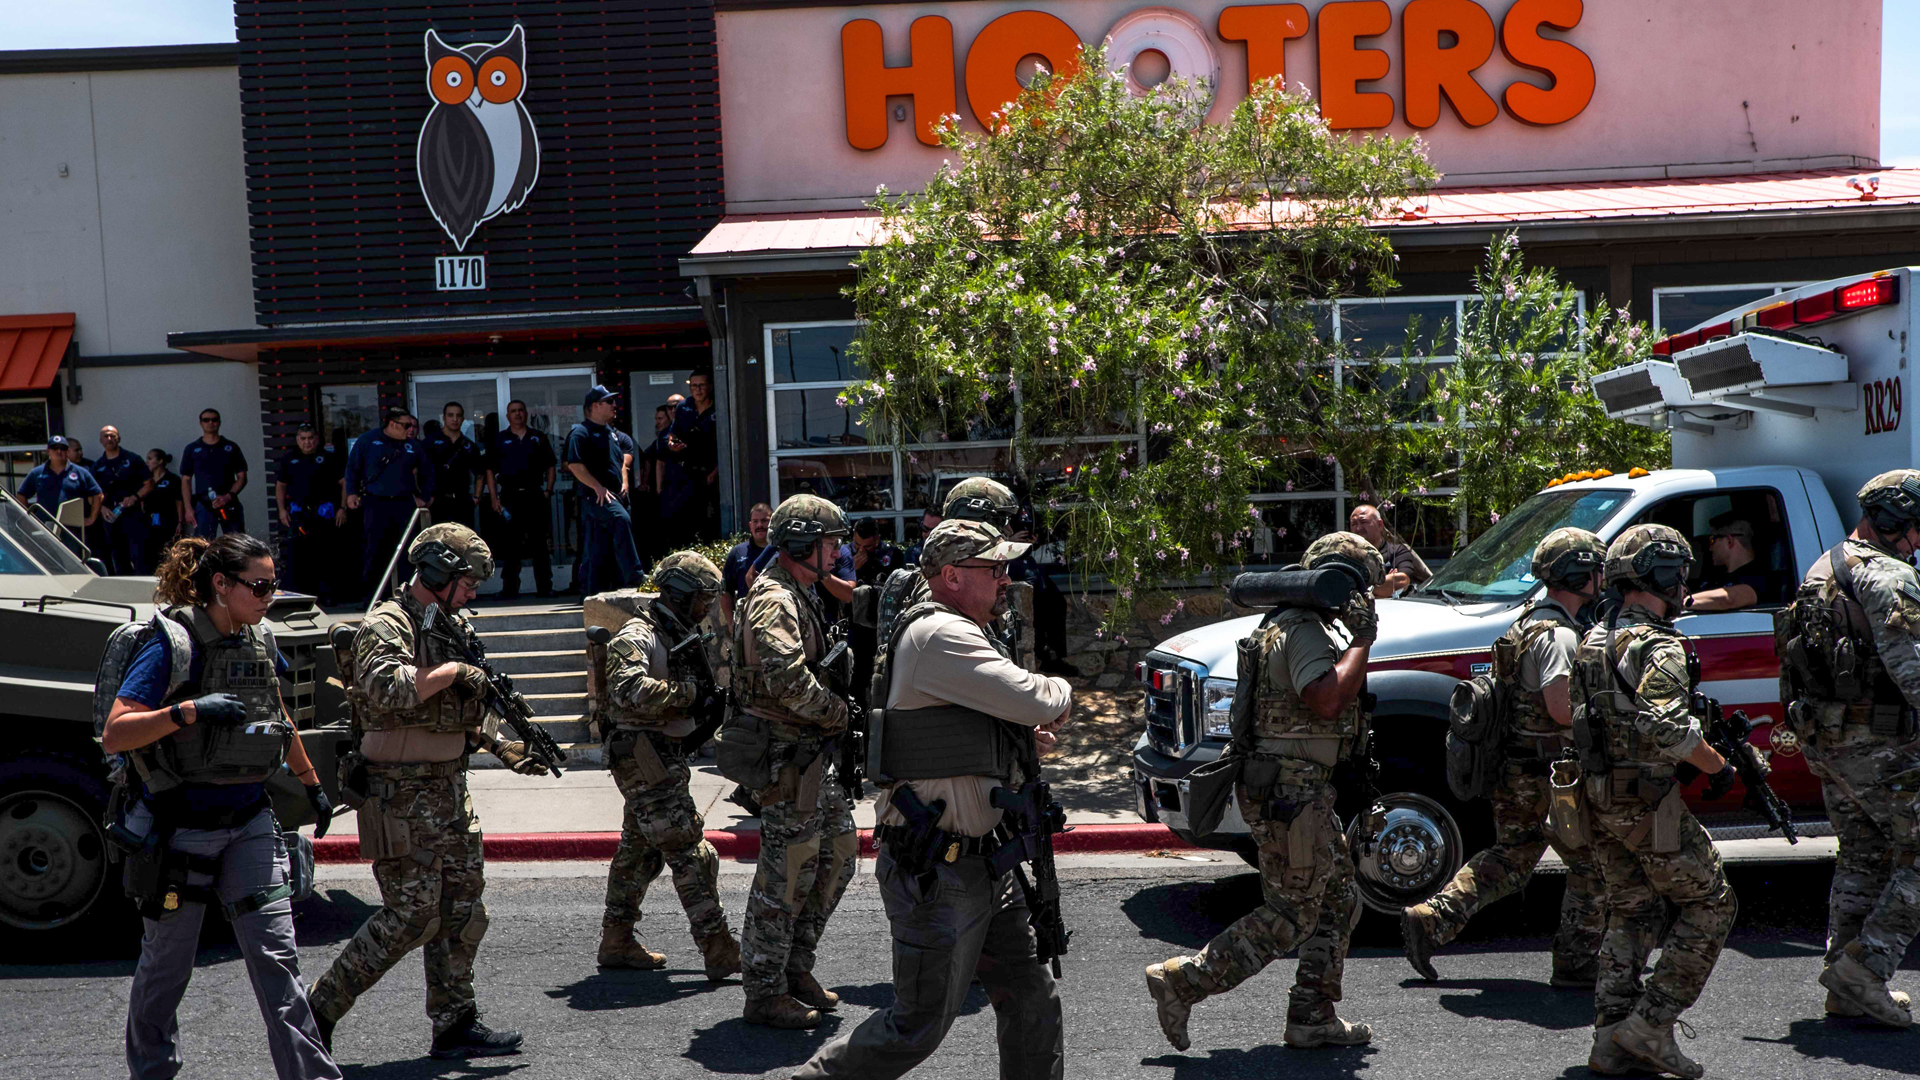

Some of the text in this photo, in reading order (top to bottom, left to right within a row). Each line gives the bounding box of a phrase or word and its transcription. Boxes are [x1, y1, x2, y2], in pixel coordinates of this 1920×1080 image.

[841, 0, 1596, 151] HOOTERS
[438, 258, 483, 288] 1170
[1863, 375, 1902, 436] RR29
[228, 677, 267, 687] NEGOTIATOR
[230, 661, 265, 678] FBI
